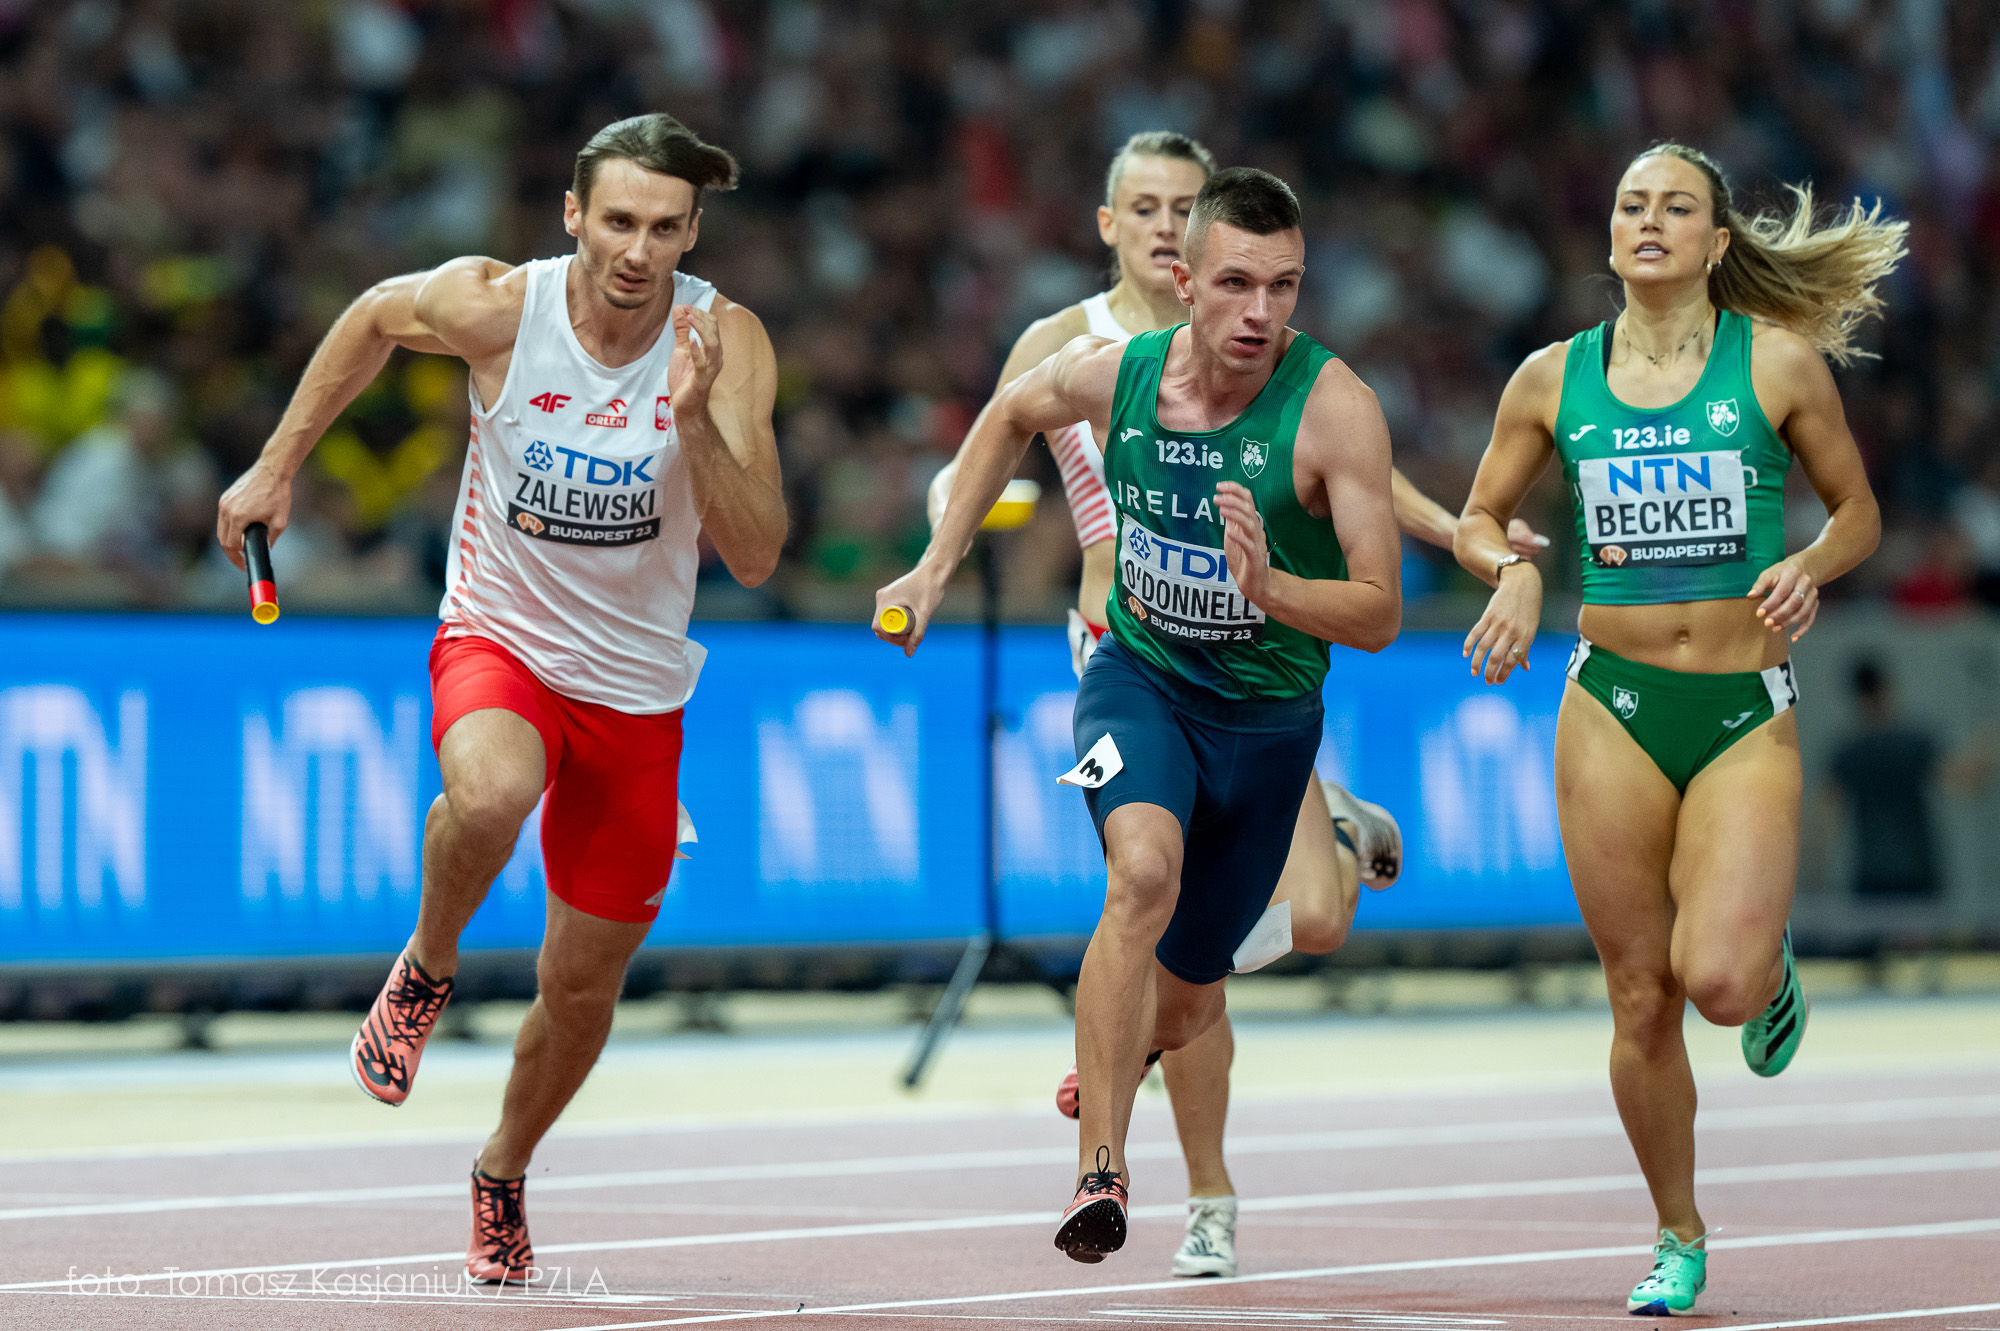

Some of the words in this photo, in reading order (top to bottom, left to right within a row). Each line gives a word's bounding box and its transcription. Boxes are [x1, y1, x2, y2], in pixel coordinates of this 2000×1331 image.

[529, 392, 572, 414] 4F
[587, 415, 625, 427] ORLEN
[1612, 425, 1691, 450] 123.ie
[555, 445, 655, 487] TDK
[1155, 440, 1224, 470] 123.ie
[1608, 455, 1712, 497] NTN
[515, 472, 656, 521] ZALEWSKI
[1117, 480, 1264, 530] IRELA
[1595, 497, 1733, 537] BECKER
[549, 525, 634, 542] BUDAPEST
[635, 525, 652, 538] 23
[1631, 543, 1717, 561] BUDAPEST
[1718, 542, 1737, 555] 23
[1125, 559, 1257, 621] O'DONNELL
[1150, 614, 1232, 641] BUDAPEST
[1233, 629, 1252, 640] 23
[1079, 757, 1104, 783] 3
